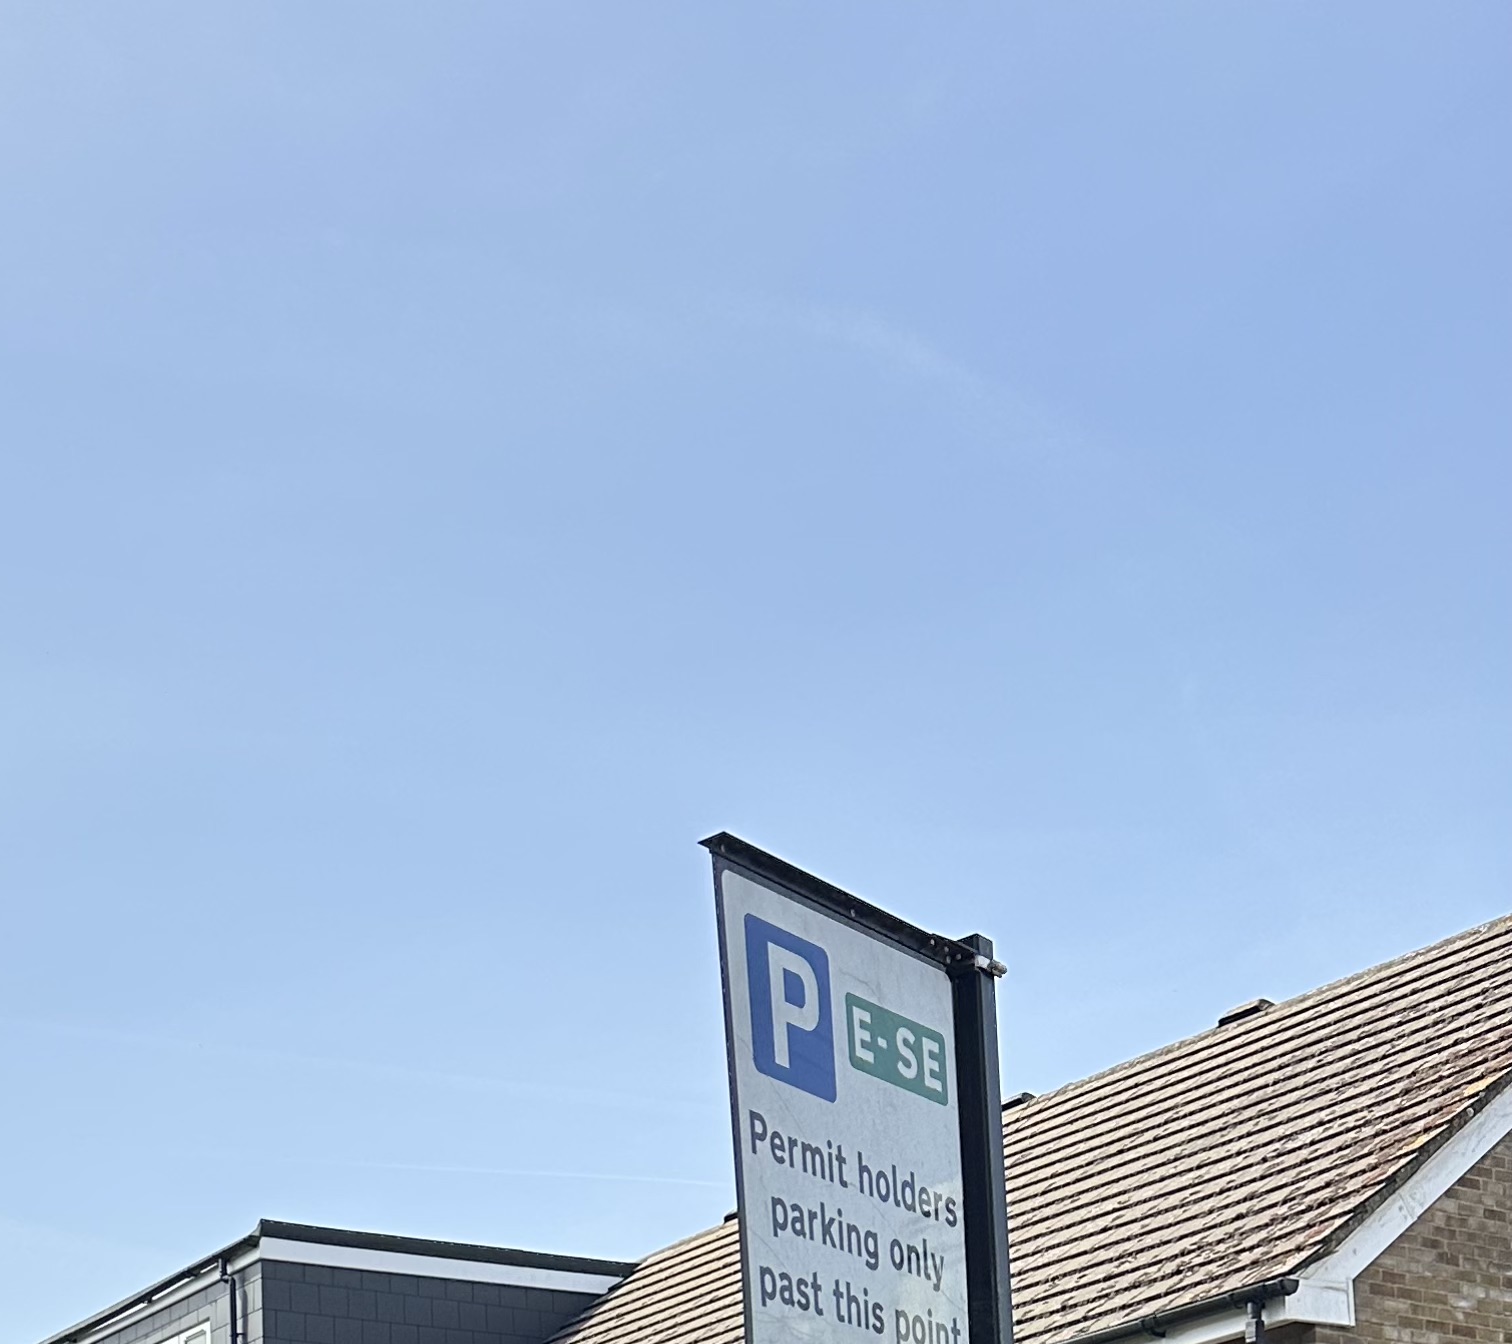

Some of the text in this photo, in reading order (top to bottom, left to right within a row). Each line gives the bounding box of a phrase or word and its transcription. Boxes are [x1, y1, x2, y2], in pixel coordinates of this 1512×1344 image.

[766, 940, 820, 1069] P
[851, 1005, 943, 1094] E-SE
[748, 1109, 958, 1228] Permit holders
[770, 1195, 945, 1292] parking only
[759, 1264, 824, 1317] past
[832, 1278, 885, 1335] this
